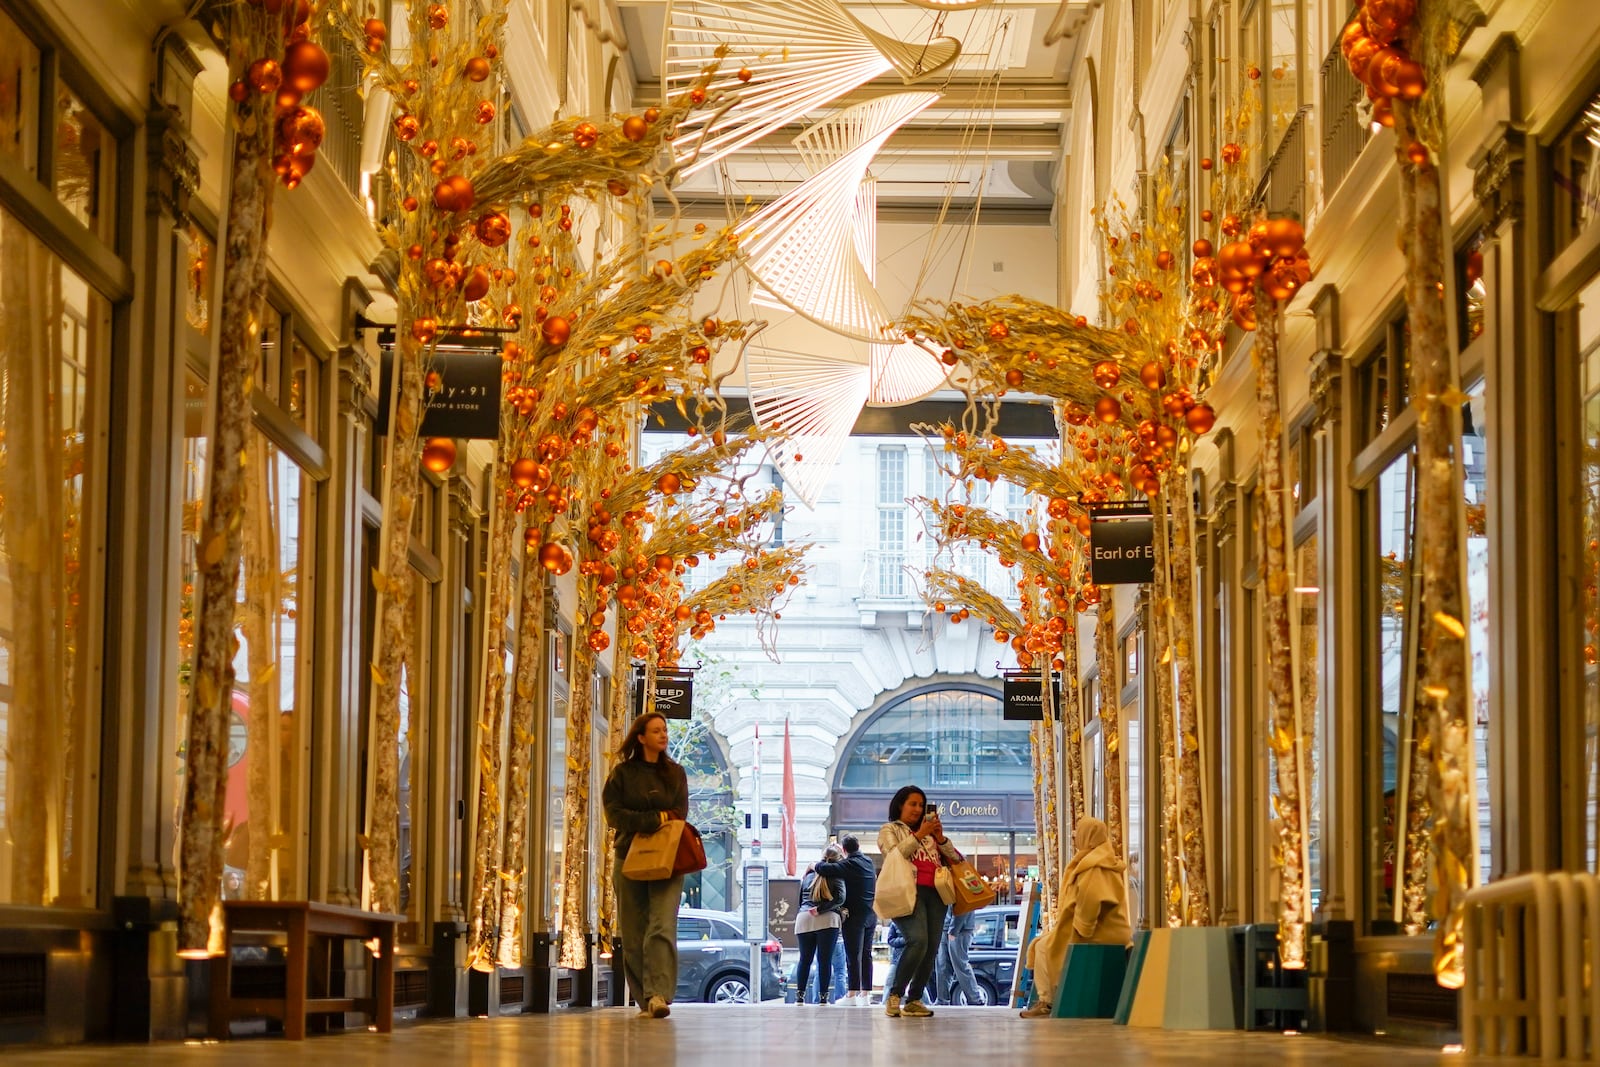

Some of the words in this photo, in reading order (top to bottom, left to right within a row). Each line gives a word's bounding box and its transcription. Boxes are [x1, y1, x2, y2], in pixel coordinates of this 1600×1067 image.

[1095, 546, 1122, 560] Earl
[1125, 546, 1141, 559] of
[949, 800, 999, 817] Concerto
